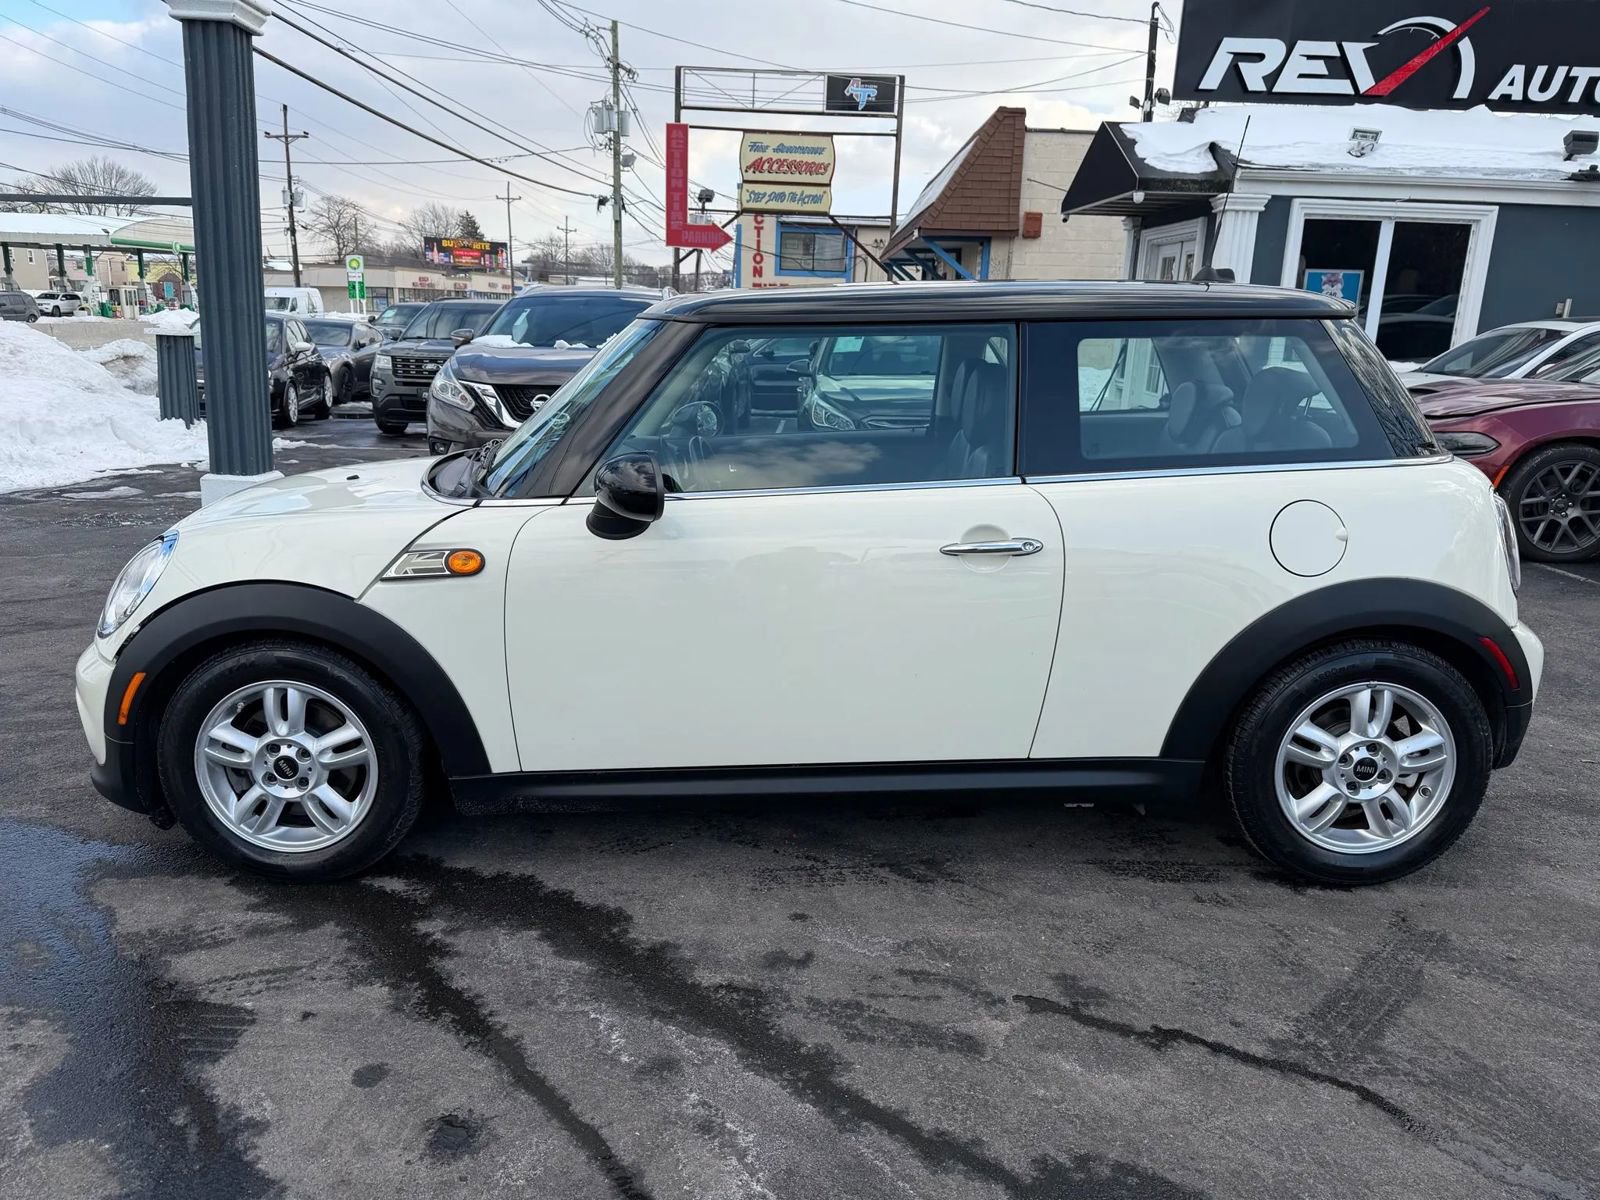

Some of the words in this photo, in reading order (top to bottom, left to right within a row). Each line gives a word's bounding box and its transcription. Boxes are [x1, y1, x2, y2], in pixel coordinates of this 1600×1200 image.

[1488, 64, 1600, 105] AUT
[744, 156, 831, 176] ACCESSORIES
[1356, 764, 1376, 775] MINI
